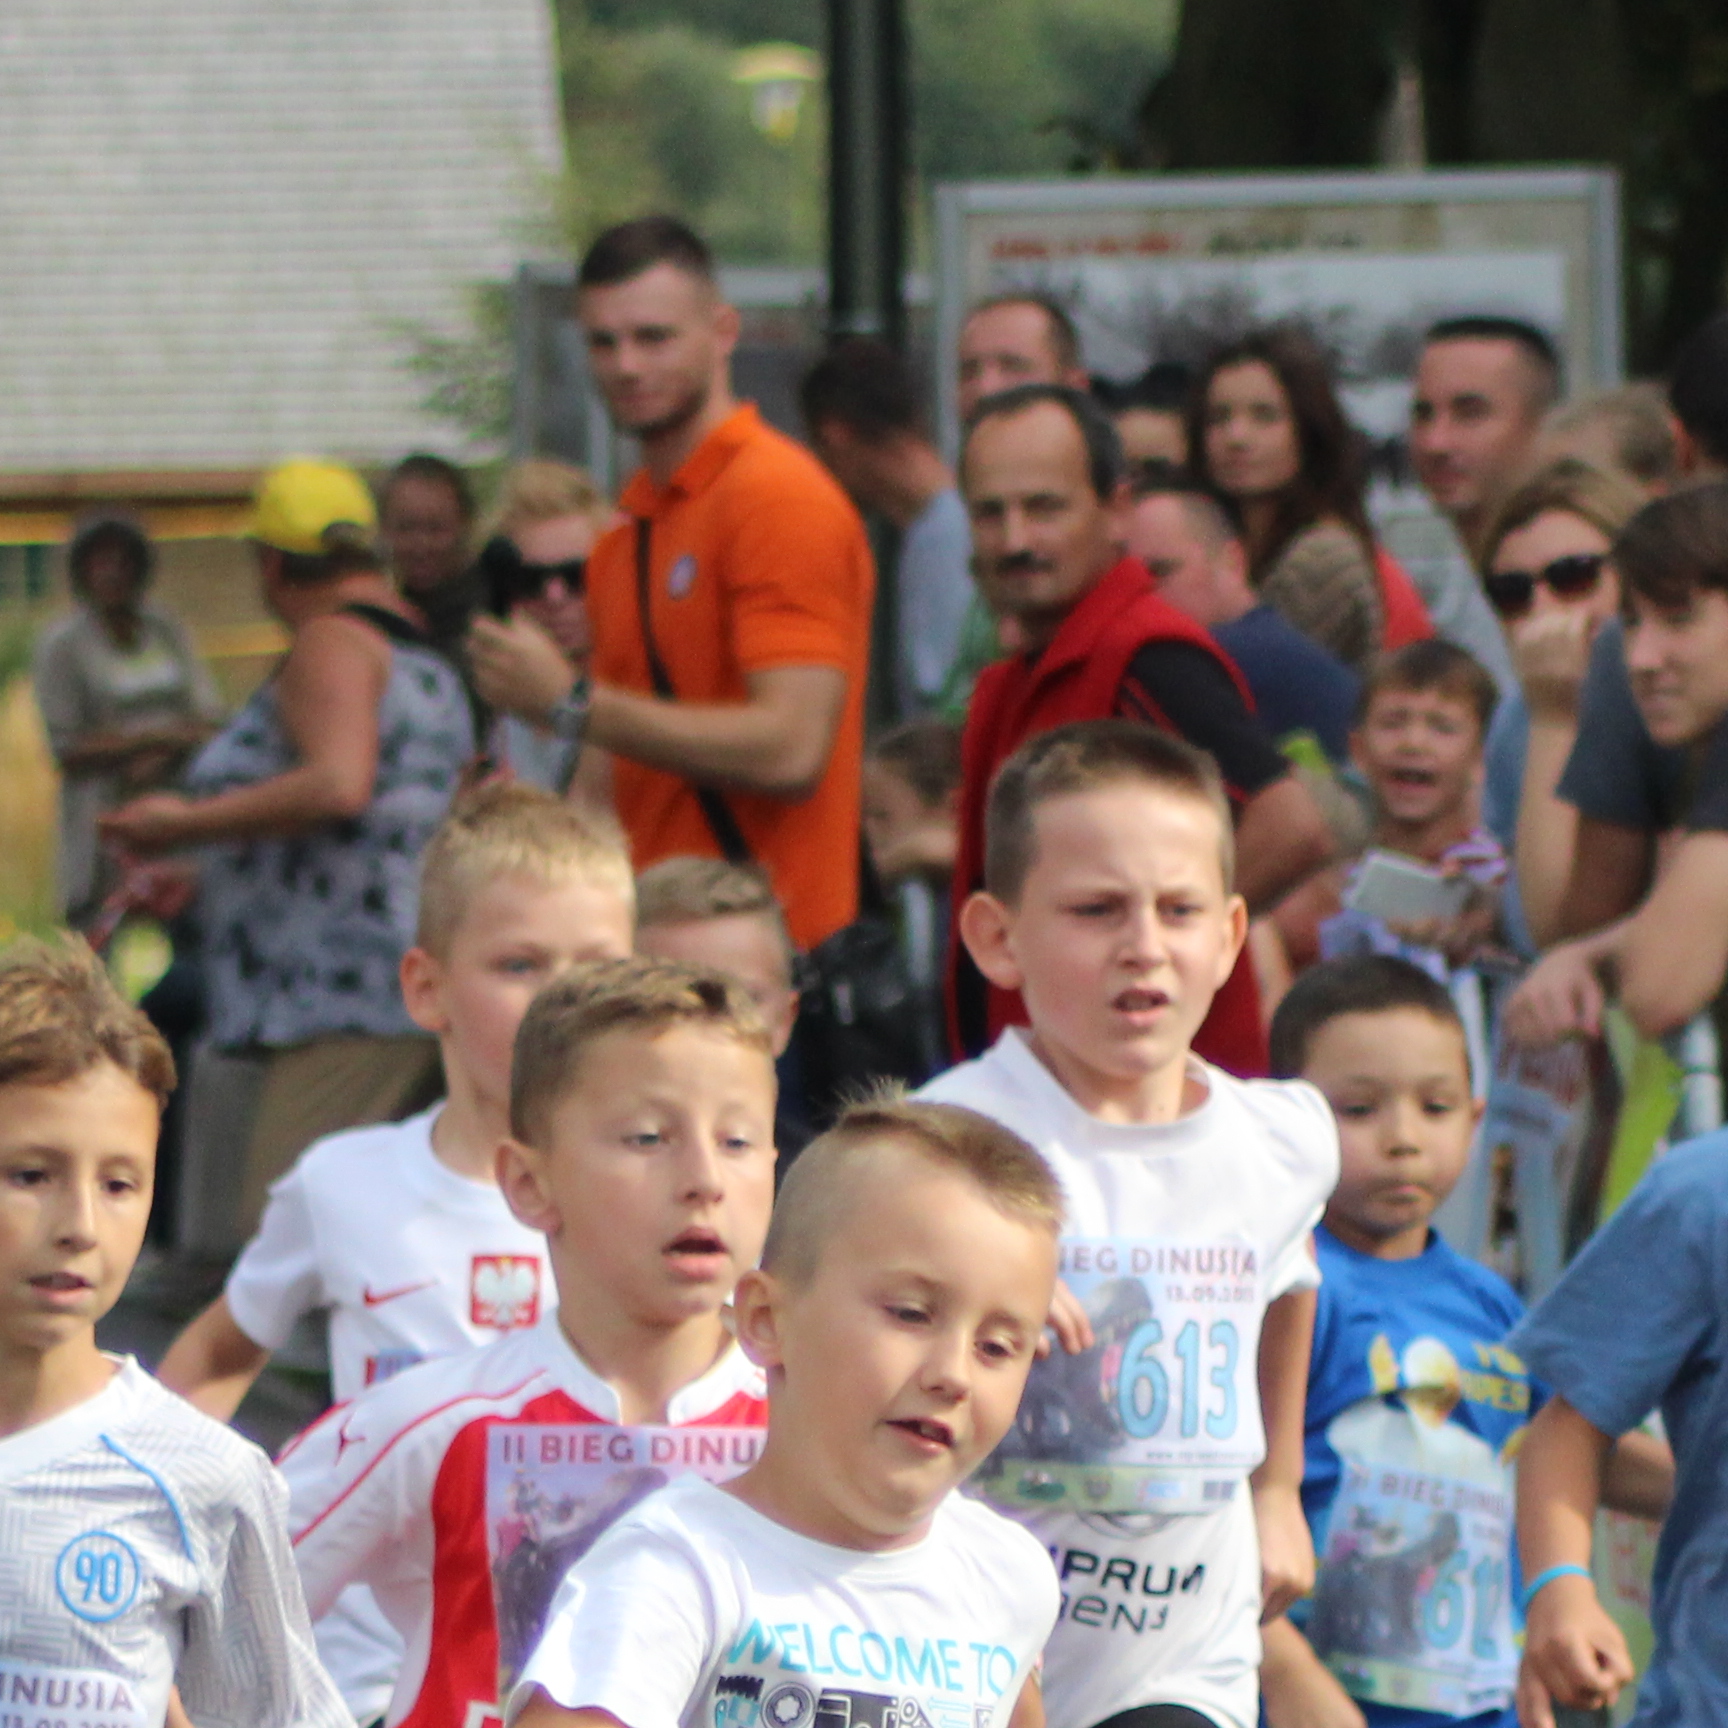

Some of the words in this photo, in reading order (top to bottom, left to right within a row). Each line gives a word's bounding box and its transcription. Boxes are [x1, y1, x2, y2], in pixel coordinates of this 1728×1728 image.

[1130, 1246, 1257, 1276] DINUSIA
[1118, 1317, 1239, 1440] 613
[503, 1434, 525, 1465] II
[540, 1433, 635, 1465] BIEG
[76, 1549, 122, 1605] 90
[726, 1616, 964, 1693] WELCOME
[968, 1642, 1021, 1698] TO
